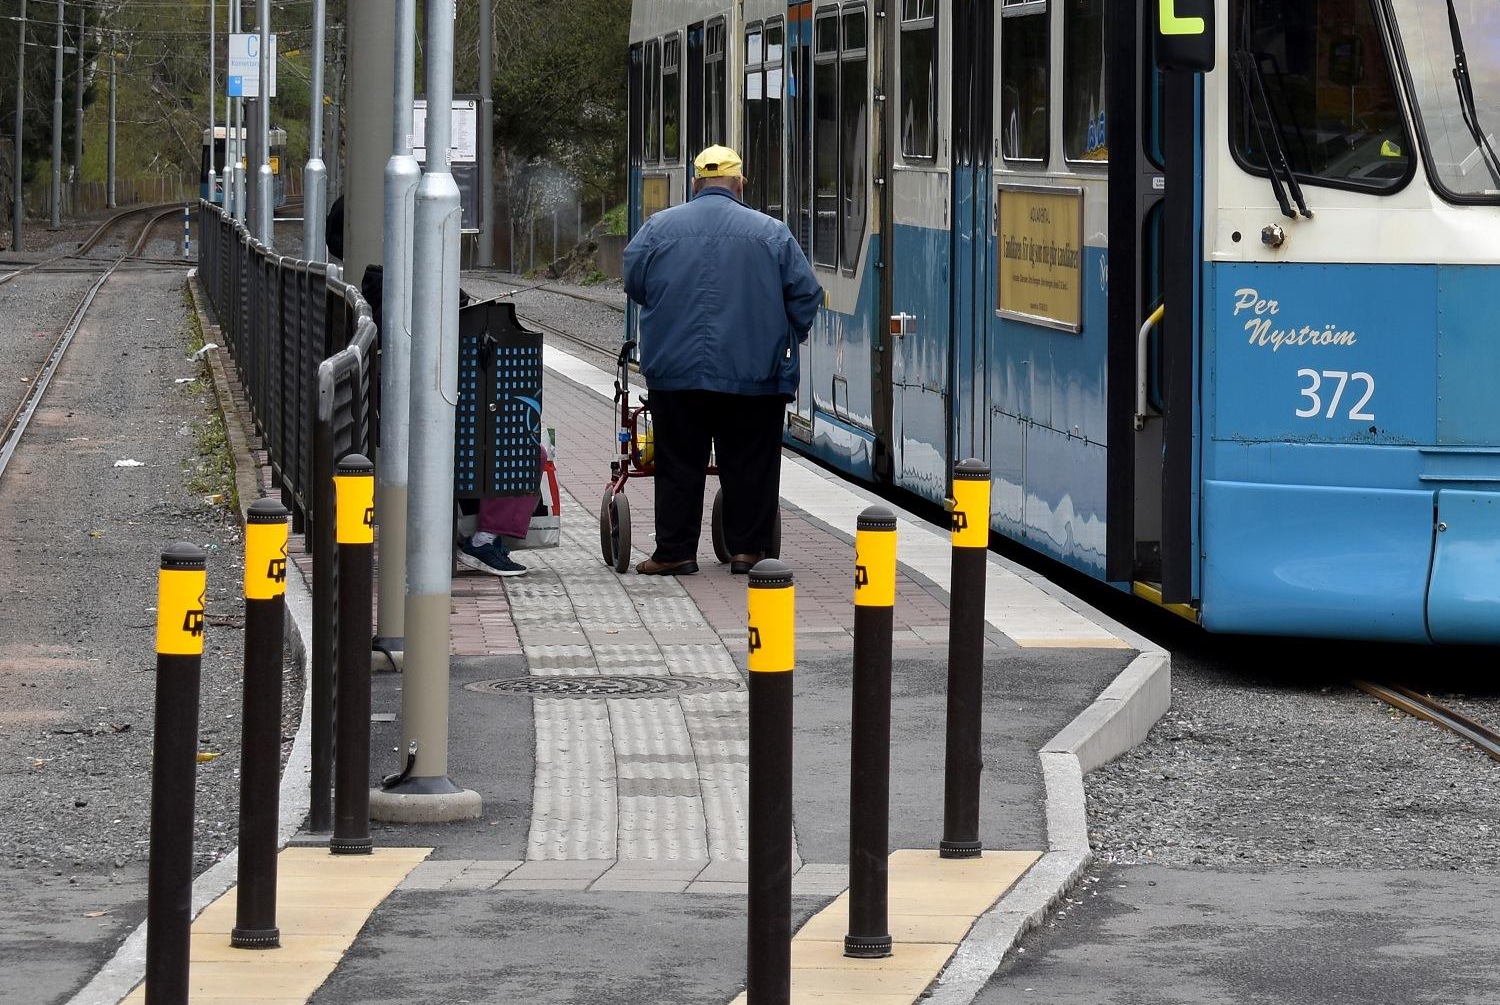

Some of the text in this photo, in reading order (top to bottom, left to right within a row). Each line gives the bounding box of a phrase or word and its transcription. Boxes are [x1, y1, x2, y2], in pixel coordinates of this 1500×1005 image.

[1233, 288, 1280, 316] Per
[1244, 318, 1357, 352] Nyström
[1295, 368, 1375, 421] 372
